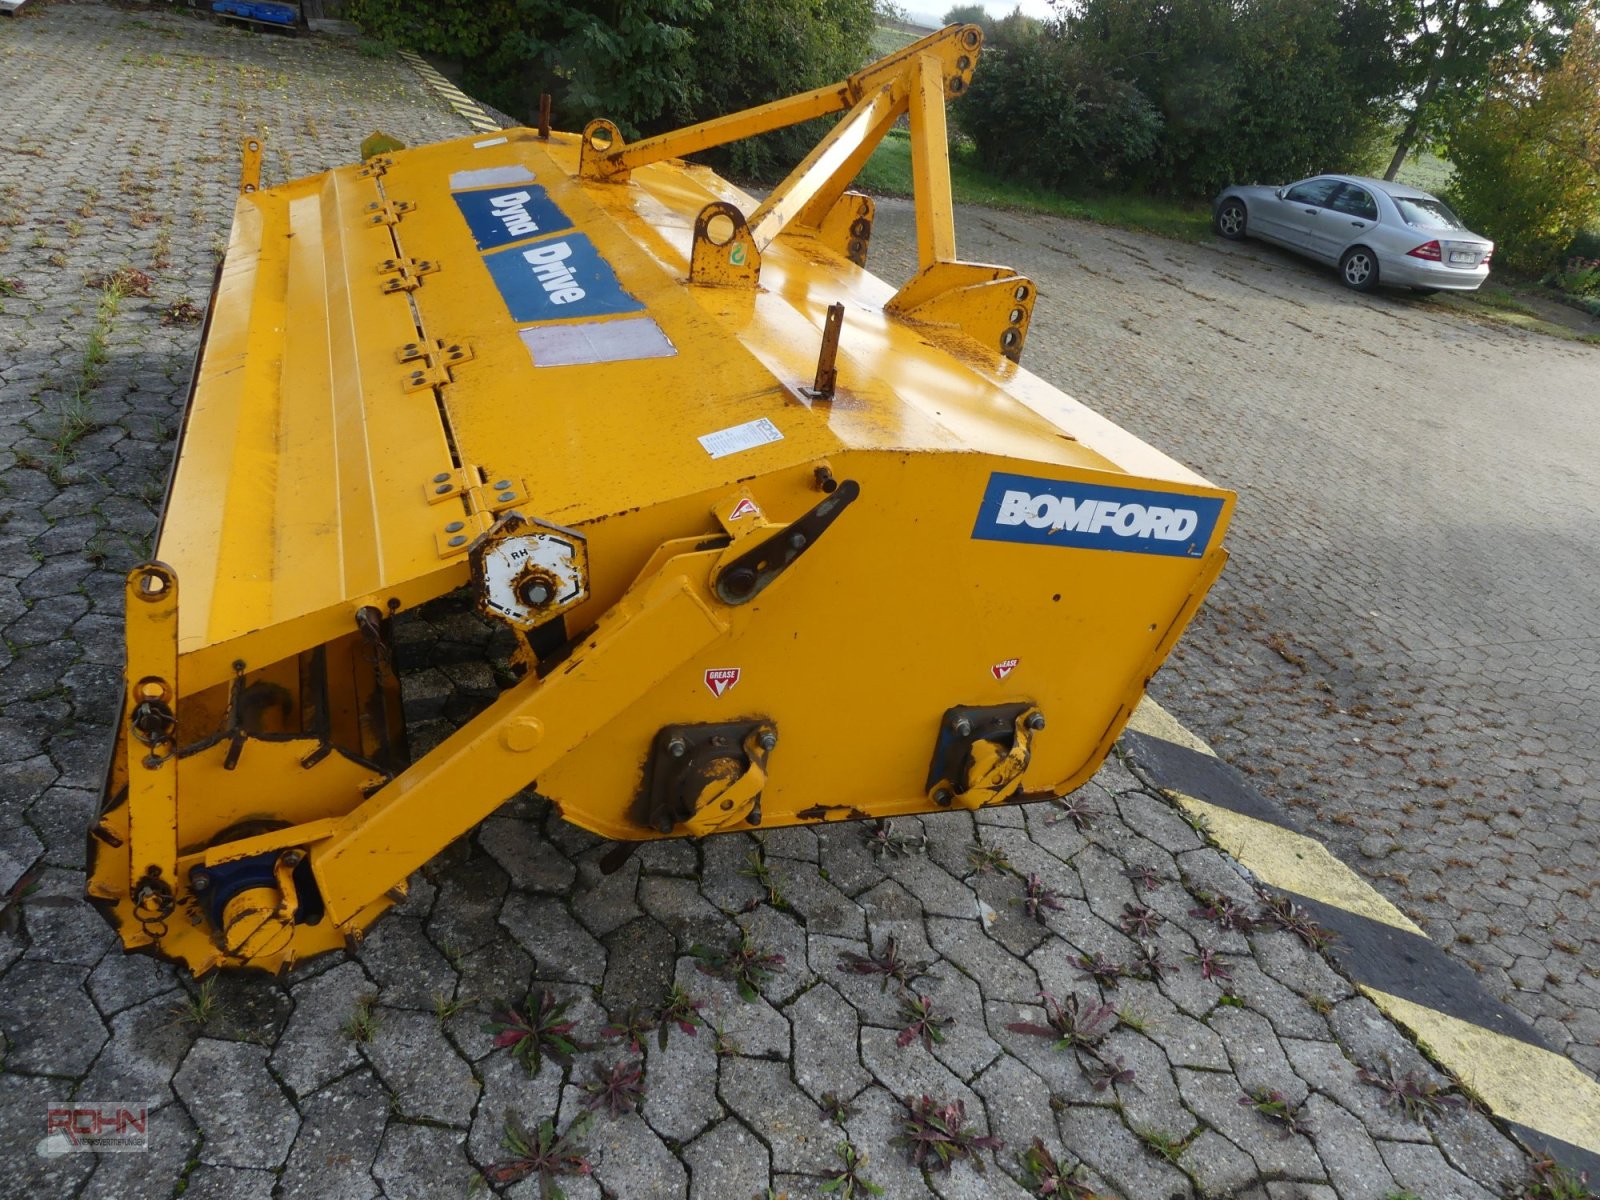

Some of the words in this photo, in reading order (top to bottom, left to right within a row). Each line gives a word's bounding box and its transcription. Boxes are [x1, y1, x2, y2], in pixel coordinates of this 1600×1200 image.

[489, 191, 539, 237] Dyna
[522, 241, 586, 305] Drive
[995, 490, 1198, 542] BOMFORD
[511, 548, 528, 560] RH
[504, 607, 511, 616] 5
[709, 670, 736, 679] GREASE
